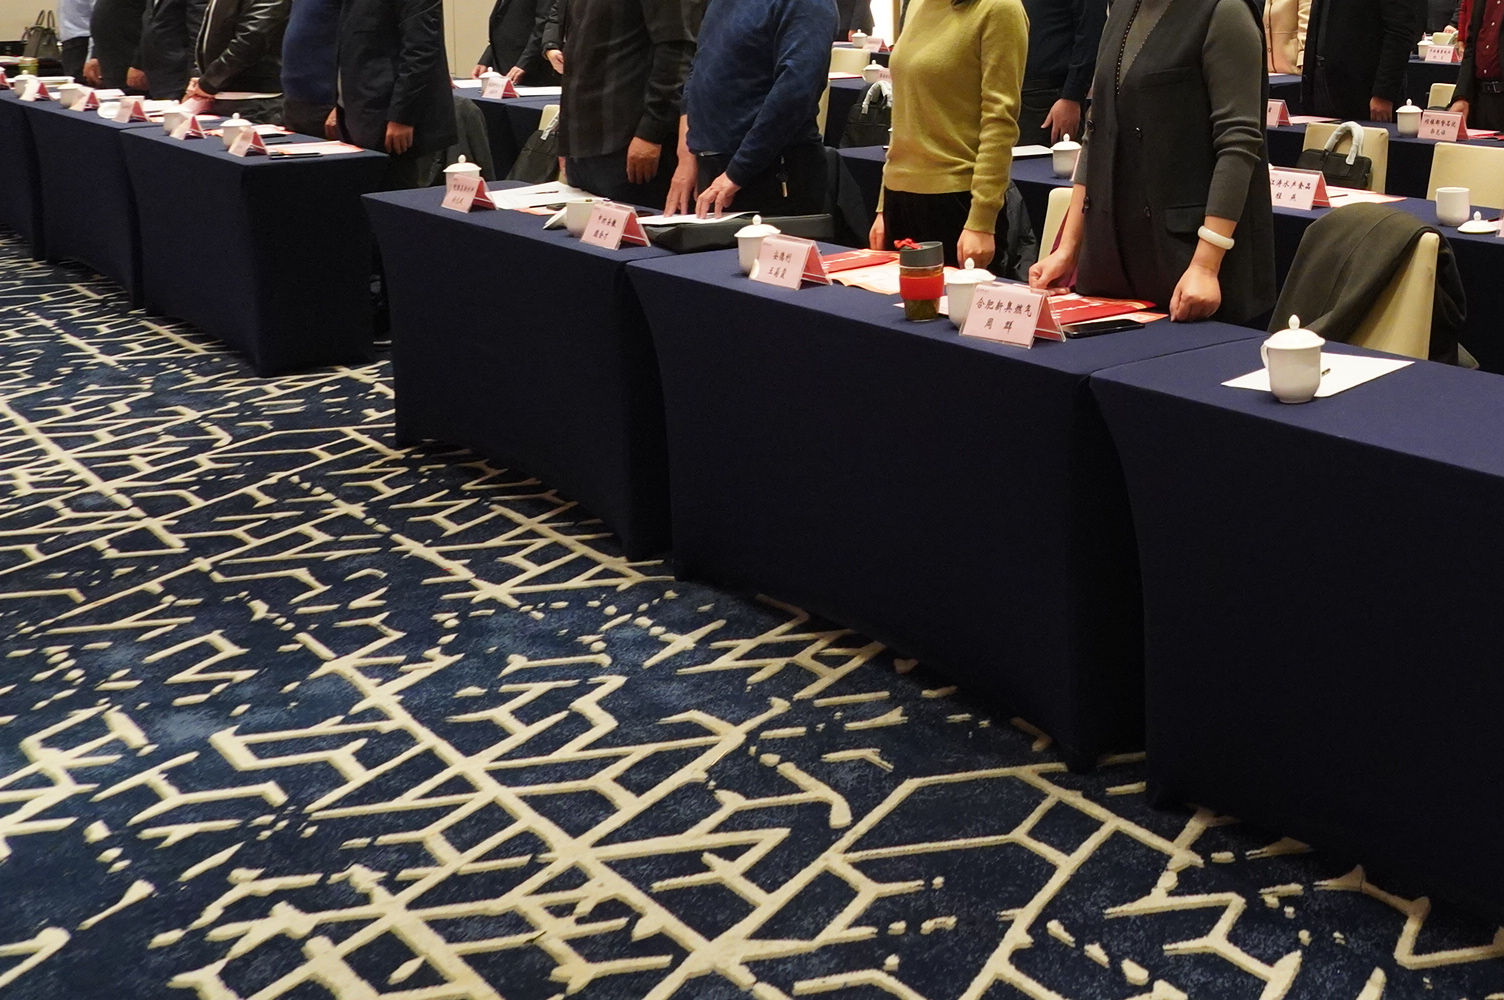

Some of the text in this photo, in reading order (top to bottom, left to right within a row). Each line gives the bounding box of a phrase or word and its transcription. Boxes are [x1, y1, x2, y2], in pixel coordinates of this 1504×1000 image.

[976, 297, 1032, 317] 合肥新奥燃气
